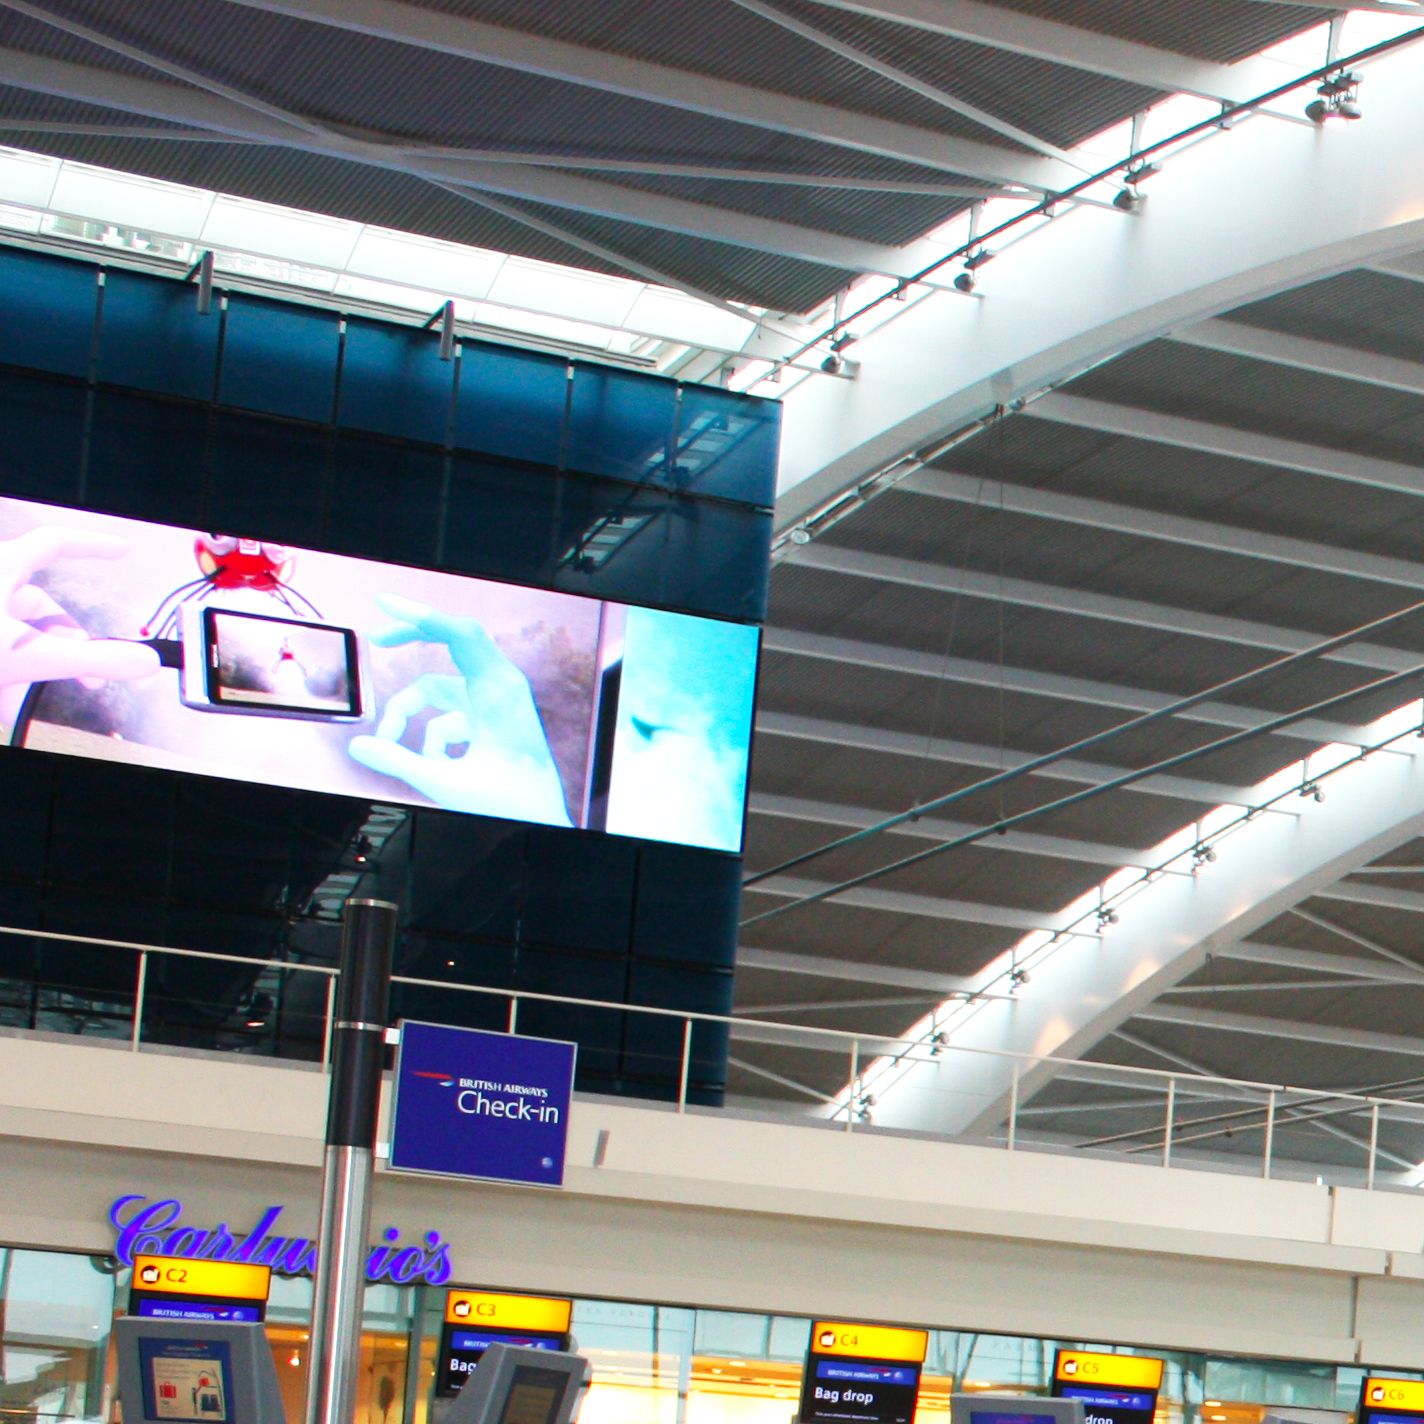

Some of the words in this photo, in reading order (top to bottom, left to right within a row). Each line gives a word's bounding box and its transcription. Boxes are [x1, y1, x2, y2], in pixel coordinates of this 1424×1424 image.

[459, 1077, 502, 1092] BRITISH
[503, 1083, 549, 1098] AIRWAYS
[457, 1089, 559, 1124] Check-in
[109, 1194, 452, 1286] Carluio's
[166, 1268, 188, 1283] C2
[152, 1308, 183, 1317] BRITISH
[183, 1311, 215, 1320] AIRWAYS
[476, 1303, 496, 1316] C3
[840, 1334, 859, 1346] C4
[1082, 1363, 1099, 1375] C5
[815, 1386, 839, 1403] Bag
[843, 1389, 874, 1406] drop
[1389, 1389, 1404, 1400] C6
